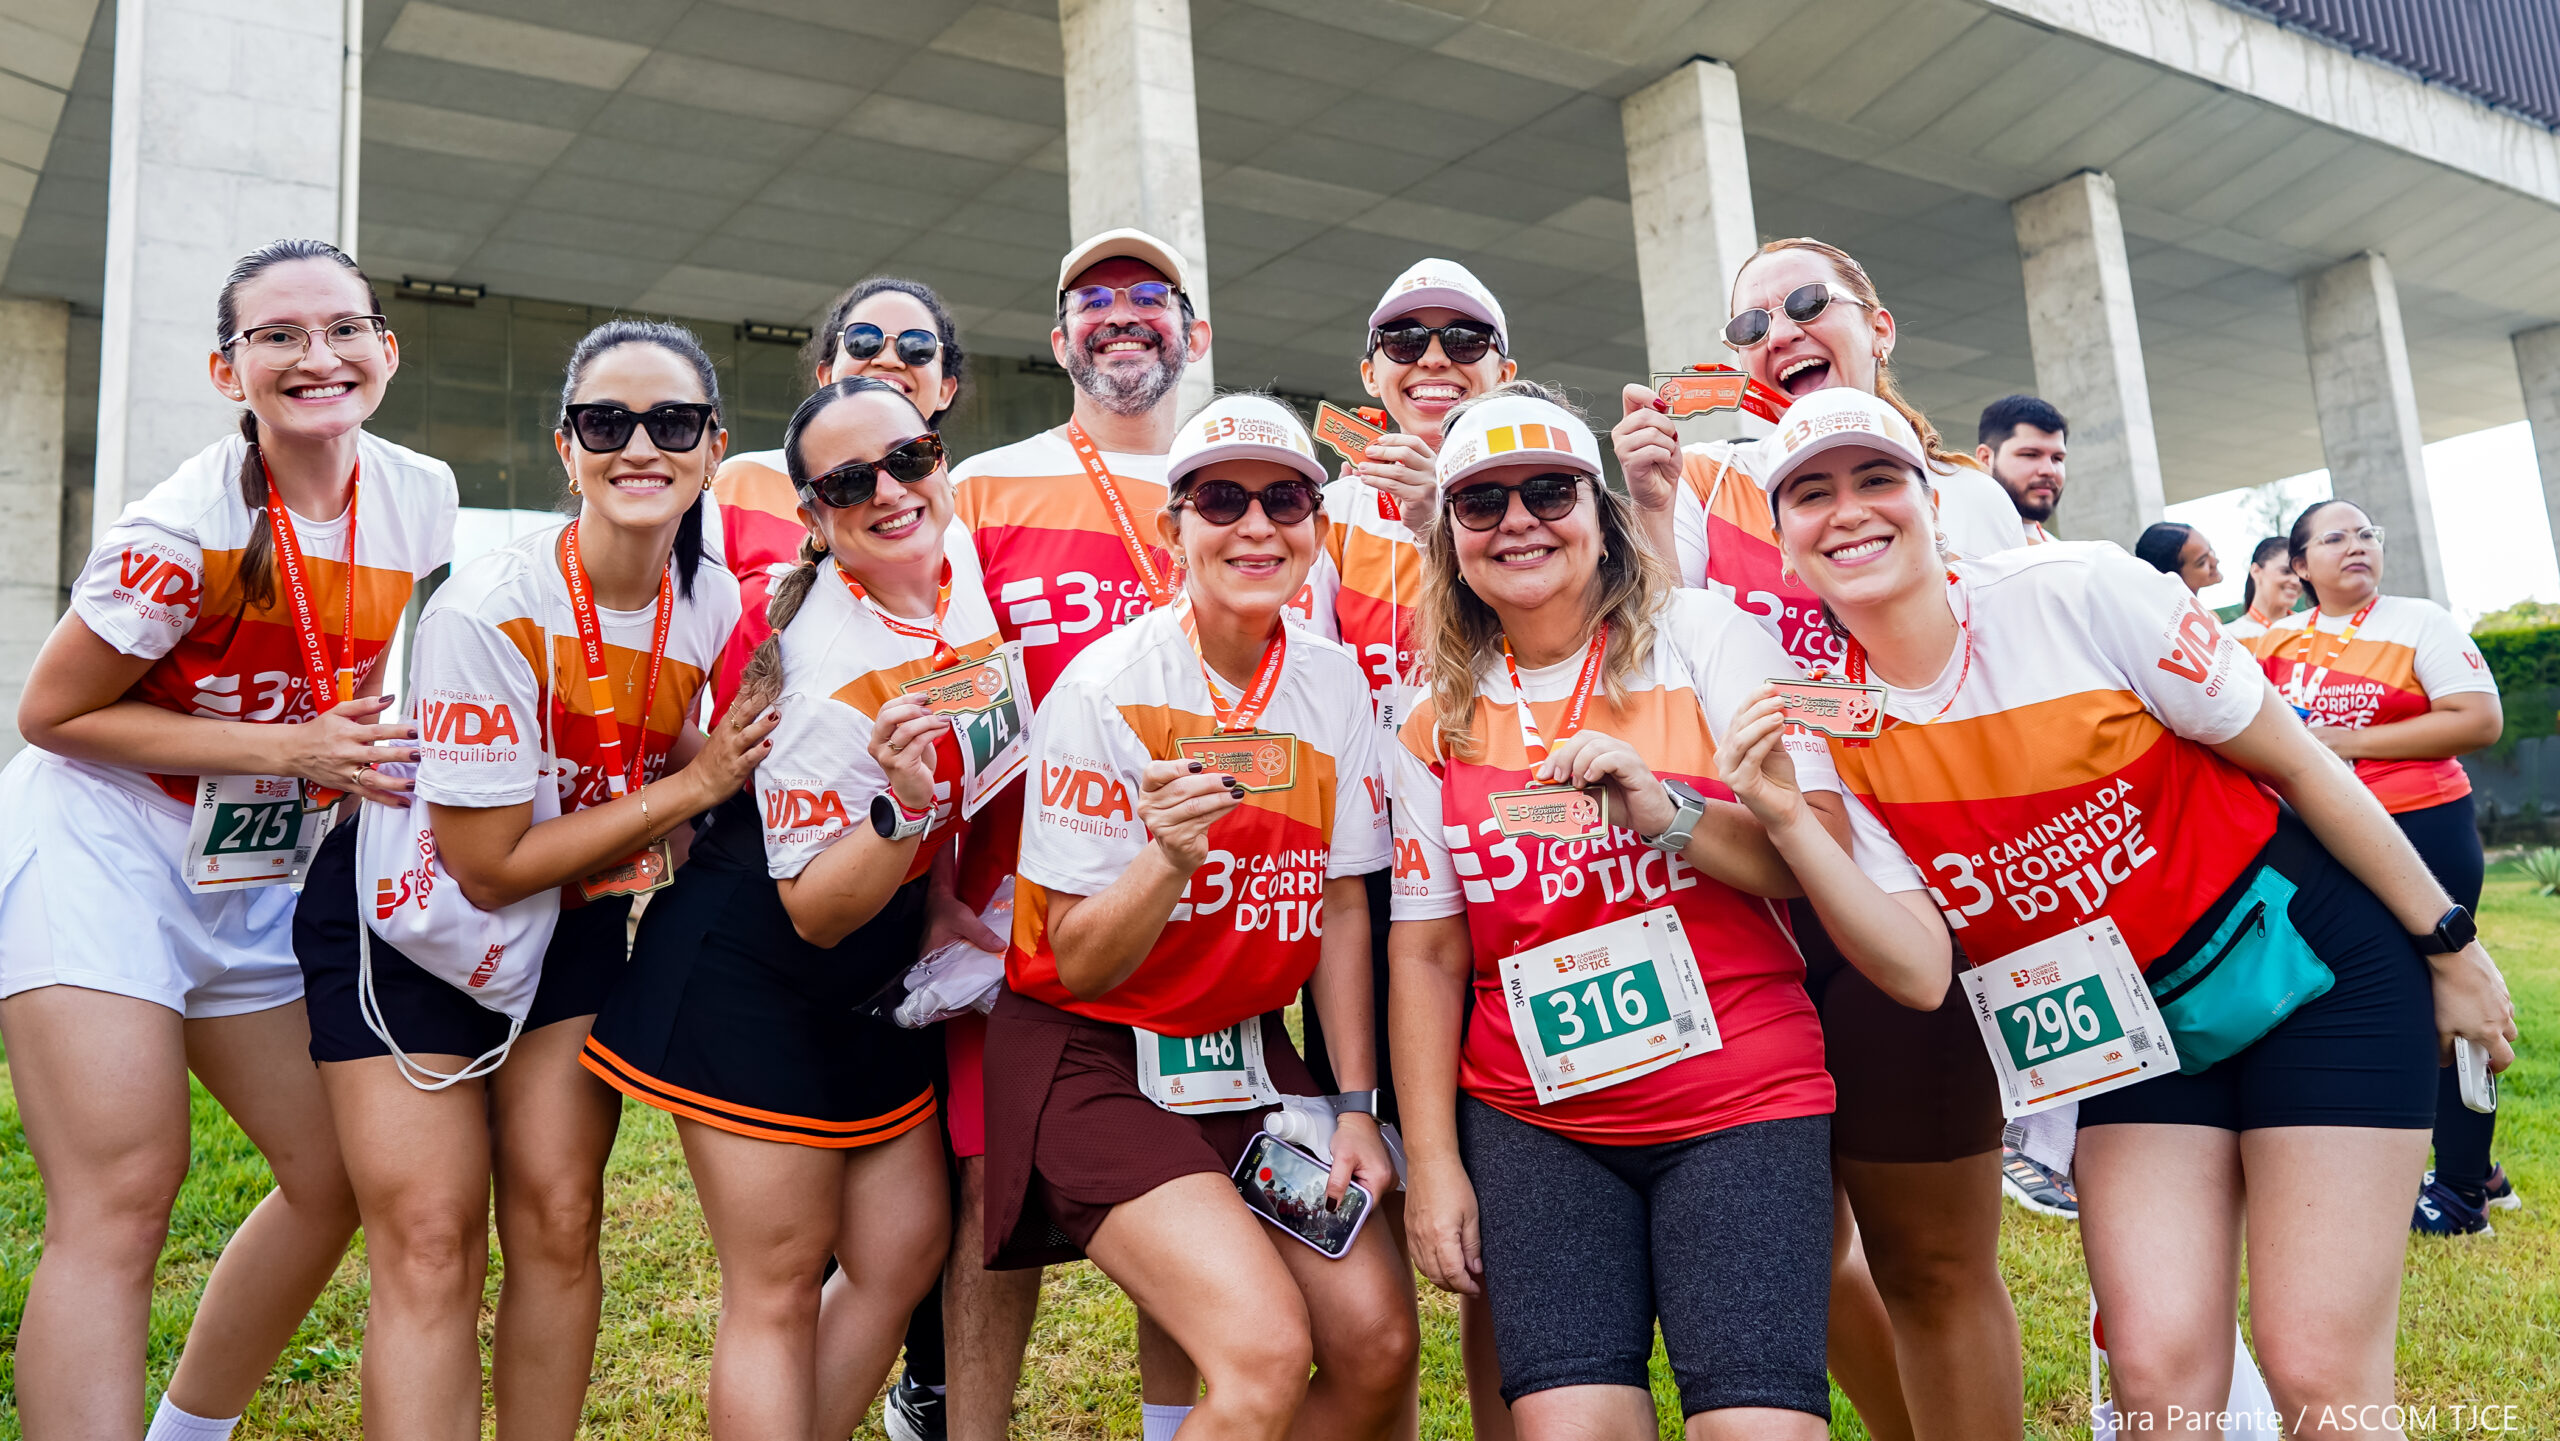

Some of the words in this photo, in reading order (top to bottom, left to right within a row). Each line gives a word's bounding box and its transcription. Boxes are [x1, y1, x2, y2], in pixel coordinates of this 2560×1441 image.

[1239, 432, 1255, 441] DO
[1106, 489, 1118, 501] DO
[576, 595, 588, 611] DO
[581, 613, 594, 635] TJCE
[305, 633, 318, 649] DO
[586, 640, 599, 664] 2026
[310, 650, 324, 672] TJCE
[317, 679, 331, 701] 2026
[433, 689, 495, 701] PROGRAMA
[2206, 674, 2226, 697] em
[422, 698, 519, 746] VIDA
[1383, 705, 1394, 730] 3KM
[421, 746, 436, 759] em
[1784, 740, 1802, 751] em
[1230, 763, 1254, 773] TJCE
[203, 782, 218, 809] 3KM
[1042, 759, 1133, 822] VIDA
[765, 789, 851, 829] VIDA
[1542, 813, 1566, 824] TJCE
[219, 804, 295, 849] 215
[1988, 777, 2134, 865] CAMINHADA
[1994, 800, 2142, 896] /CORRIDA
[1539, 866, 1585, 905] DO
[1588, 850, 1697, 904] TJCE
[2007, 885, 2060, 922] DO
[2054, 822, 2158, 915] TJCE
[1238, 870, 1323, 901] /CORRI
[1235, 903, 1271, 931] DO
[1274, 898, 1322, 941] TJC
[1578, 963, 1588, 971] DO
[1589, 957, 1611, 971] TJCE
[2041, 972, 2062, 985] TJCE
[1510, 978, 1525, 1008] 3KM
[1548, 970, 1648, 1046] 316
[1975, 991, 1992, 1022] 3KM
[2012, 985, 2101, 1061] 296
[1559, 1064, 1576, 1074] TJCE
[1170, 1086, 1184, 1094] TJCE
[2030, 1077, 2045, 1088] TJCE
